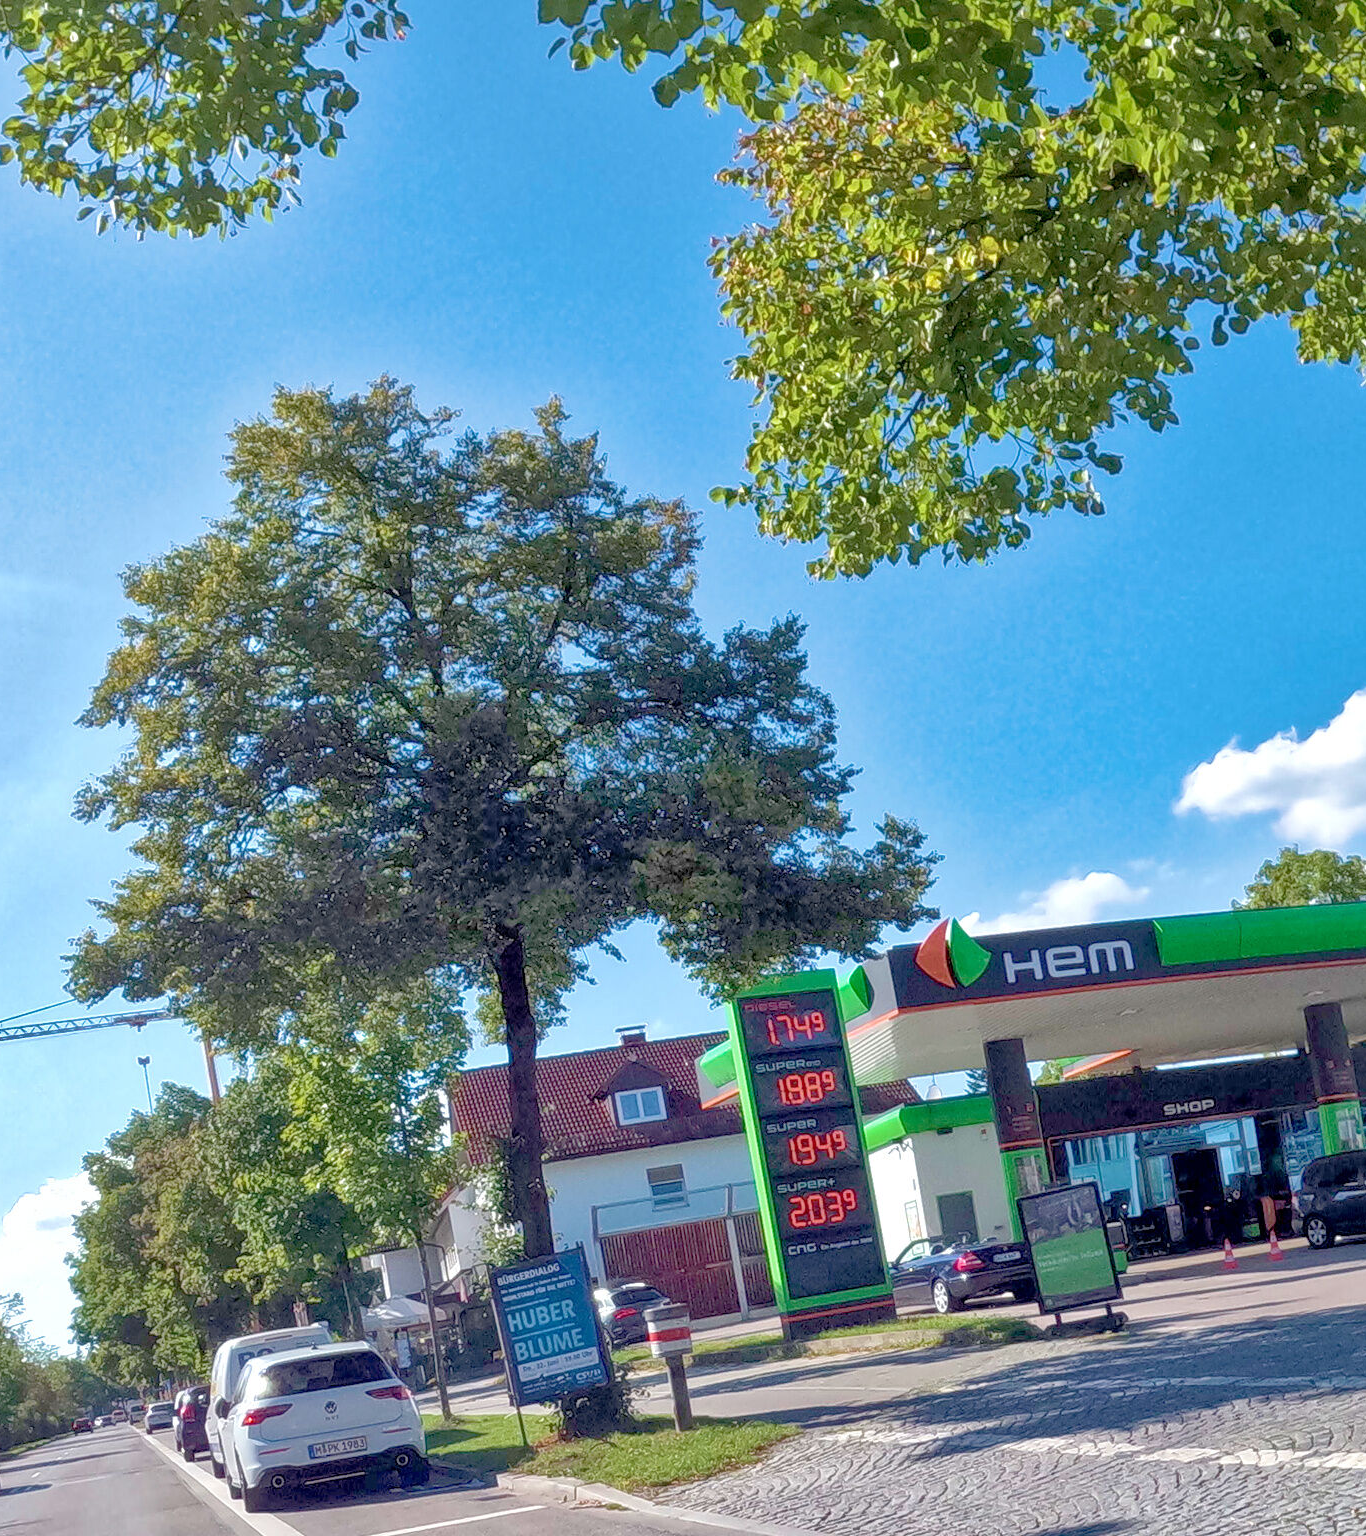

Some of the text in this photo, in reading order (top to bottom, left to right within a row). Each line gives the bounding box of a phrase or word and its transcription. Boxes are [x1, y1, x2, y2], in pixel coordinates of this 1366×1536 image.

[1002, 939, 1135, 984] HEM
[755, 1058, 806, 1073] SUPER
[1162, 1098, 1216, 1117] SHOP
[766, 1118, 817, 1134] SUPER
[776, 1177, 836, 1194] SUPER+
[787, 1242, 817, 1256] CNG
[496, 1262, 561, 1287] BÜRGERDIALOG
[506, 1299, 577, 1333] HUBER
[514, 1327, 585, 1362] BLUME
